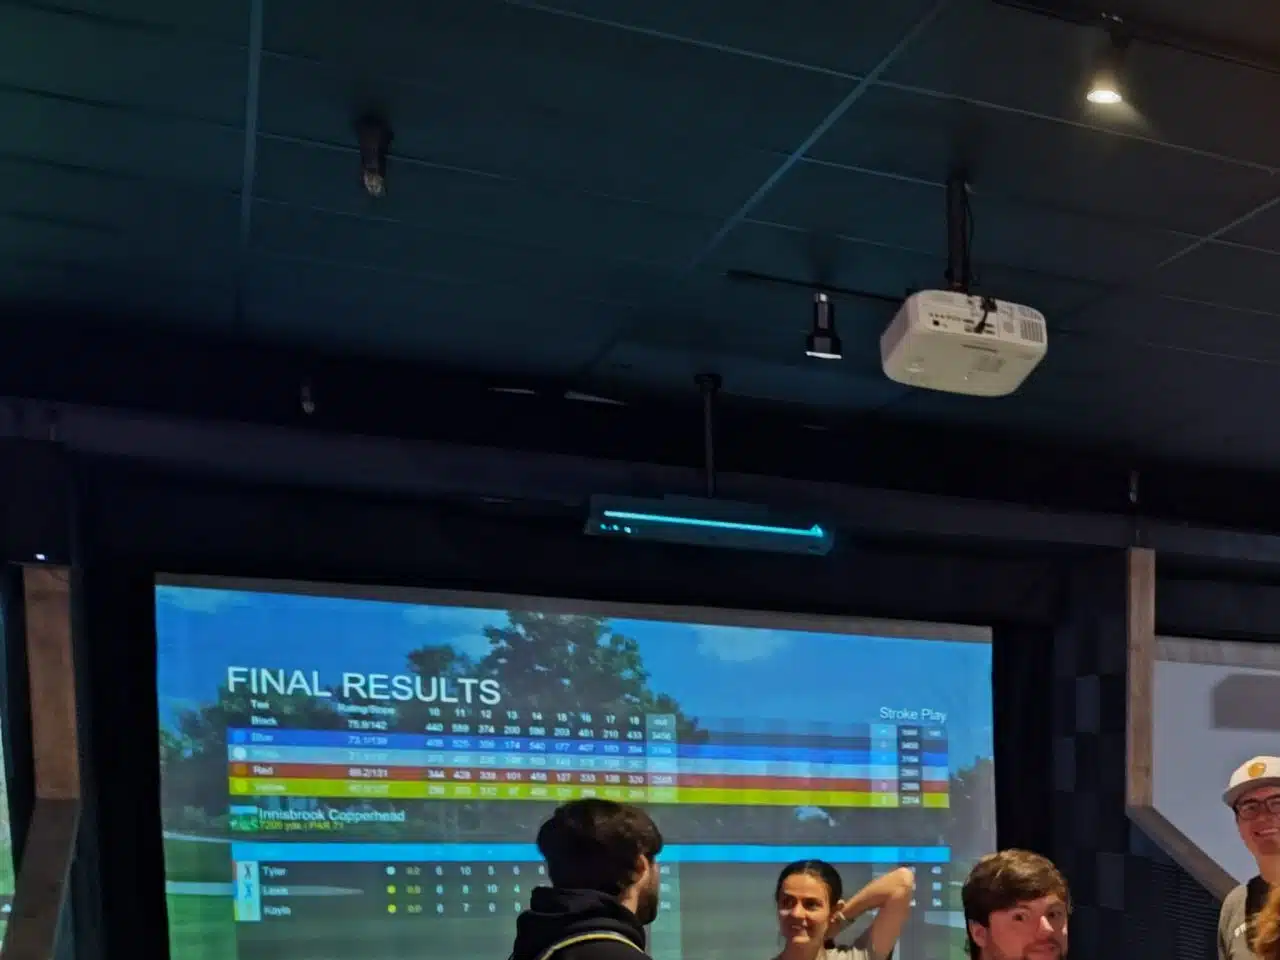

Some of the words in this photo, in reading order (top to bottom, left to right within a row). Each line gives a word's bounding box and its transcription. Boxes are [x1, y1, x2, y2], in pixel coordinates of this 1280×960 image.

[227, 666, 332, 697] FINAL
[343, 672, 501, 705] RESULTS
[454, 708, 466, 717] 11
[480, 709, 492, 719] 12
[506, 710, 518, 720] 13
[531, 711, 543, 720] 14
[605, 714, 616, 724] 17
[879, 706, 918, 721] Stroke
[921, 708, 947, 724] Play
[252, 764, 274, 775] Red
[258, 807, 325, 822] Innisbrook
[327, 807, 407, 825] Copperhead
[261, 865, 288, 878] Tyler
